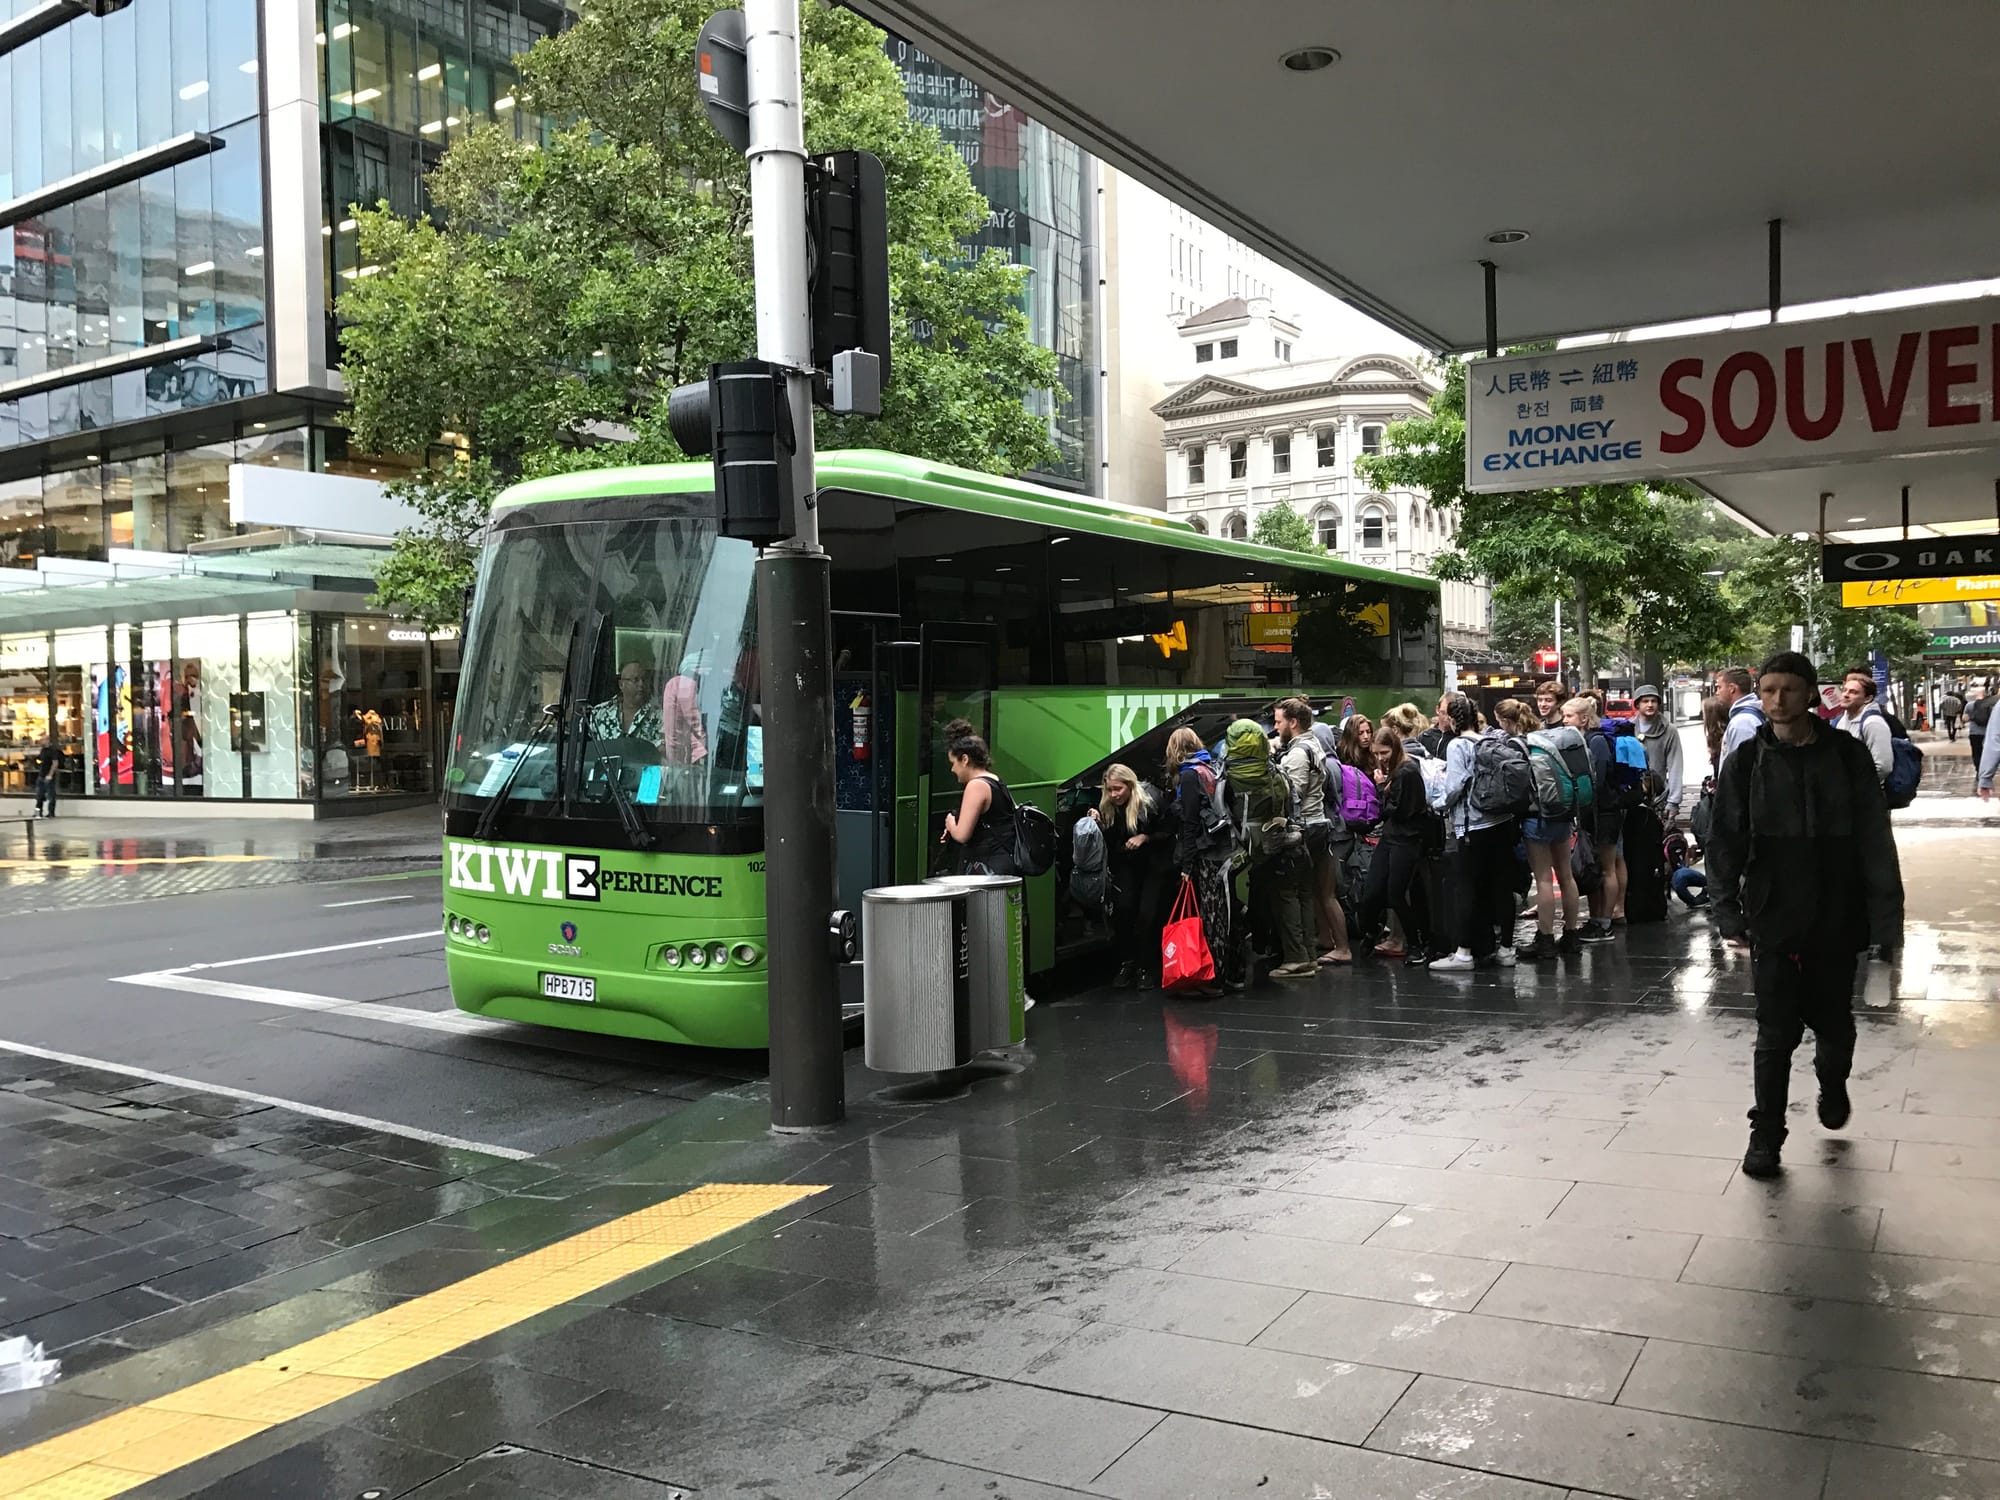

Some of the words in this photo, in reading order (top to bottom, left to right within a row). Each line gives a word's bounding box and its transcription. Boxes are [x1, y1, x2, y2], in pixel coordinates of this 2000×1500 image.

[1485, 368, 1551, 397] 人民幣
[1592, 358, 1639, 385] 紐幣
[1659, 323, 2000, 454] SOUVE
[1517, 400, 1550, 419] 환전
[1508, 419, 1615, 447] MONEY
[1483, 440, 1642, 471] EXCHANGE
[1918, 549, 1994, 566] OAK
[382, 717, 408, 731] ALE
[448, 842, 563, 900] KIWI
[566, 854, 722, 900] EXPERIENCE
[959, 925, 970, 980] Litter
[546, 976, 593, 998] HPB715
